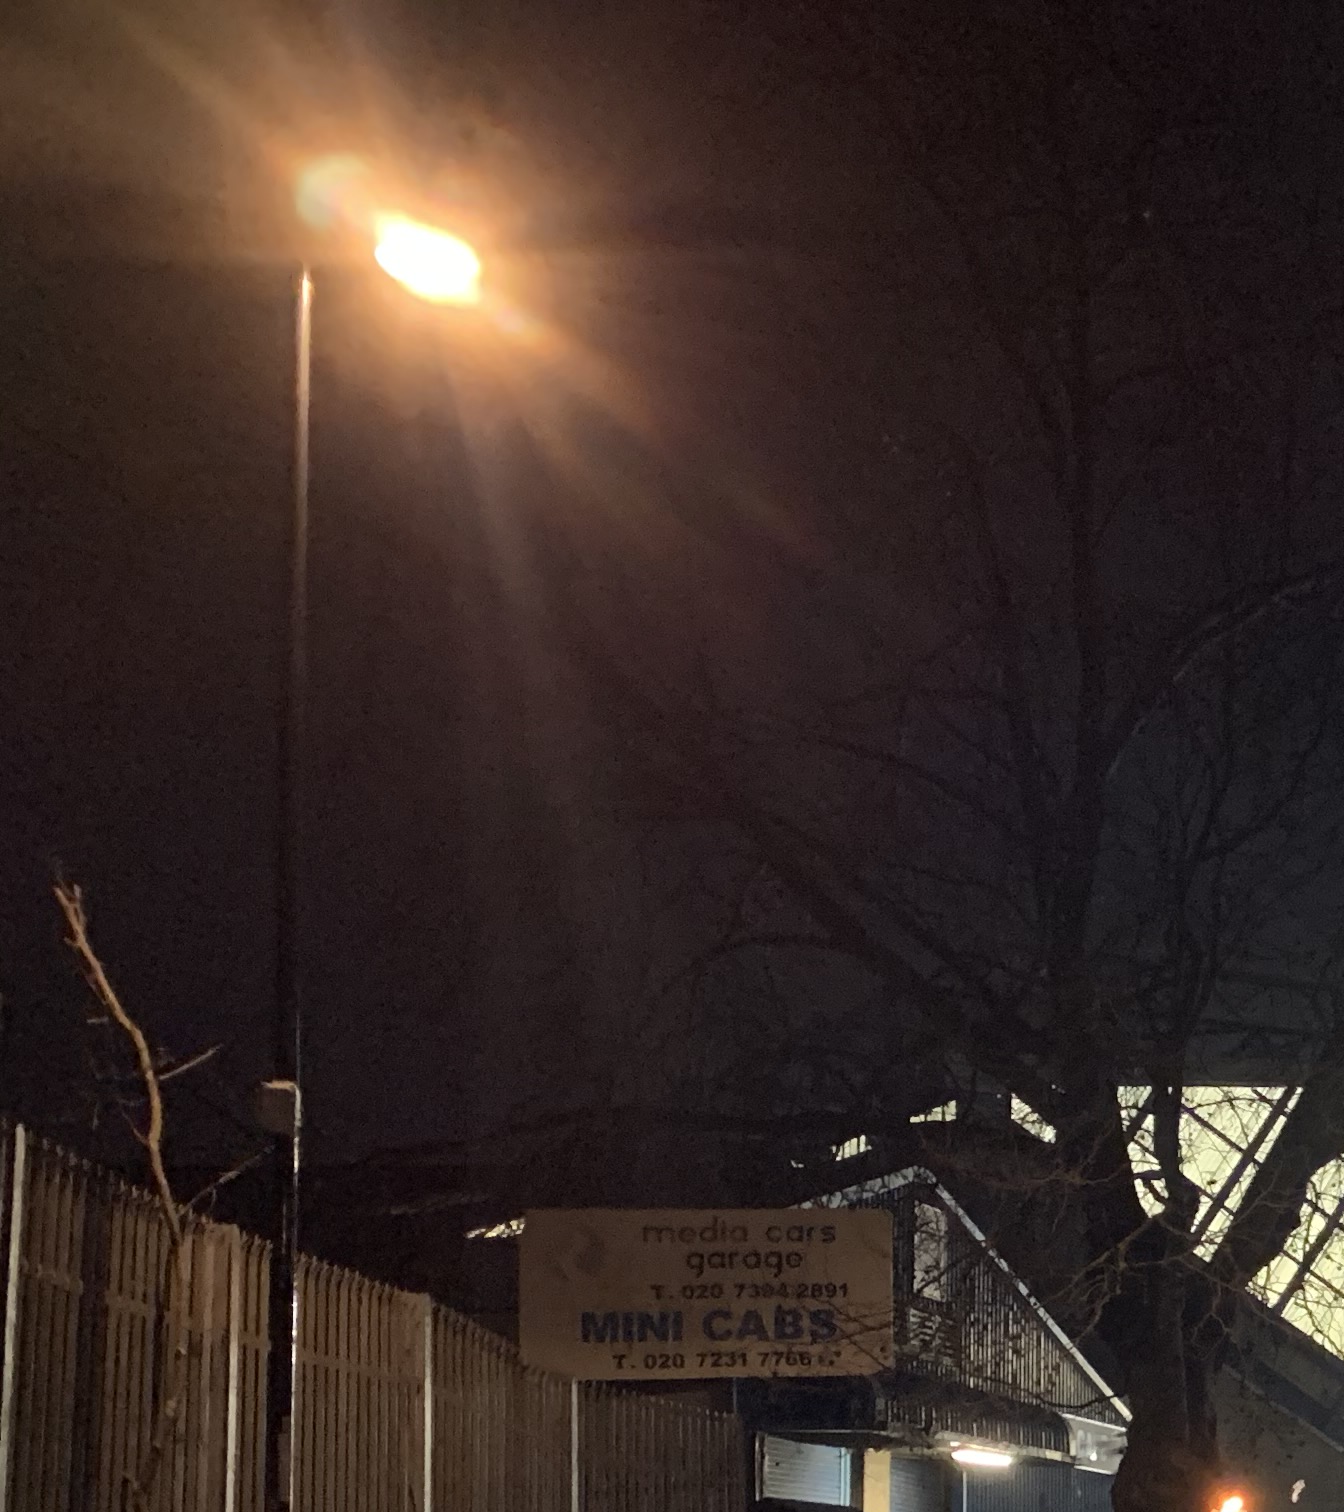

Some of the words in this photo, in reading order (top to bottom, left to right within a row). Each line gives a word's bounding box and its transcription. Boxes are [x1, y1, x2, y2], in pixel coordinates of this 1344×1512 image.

[642, 1216, 748, 1243] media
[765, 1223, 836, 1244] cars
[685, 1249, 803, 1277] garage
[680, 1283, 724, 1299] 020
[581, 1311, 683, 1343] MINI
[702, 1307, 838, 1343] CABS
[644, 1353, 685, 1370] 020
[696, 1351, 747, 1368] 7231
